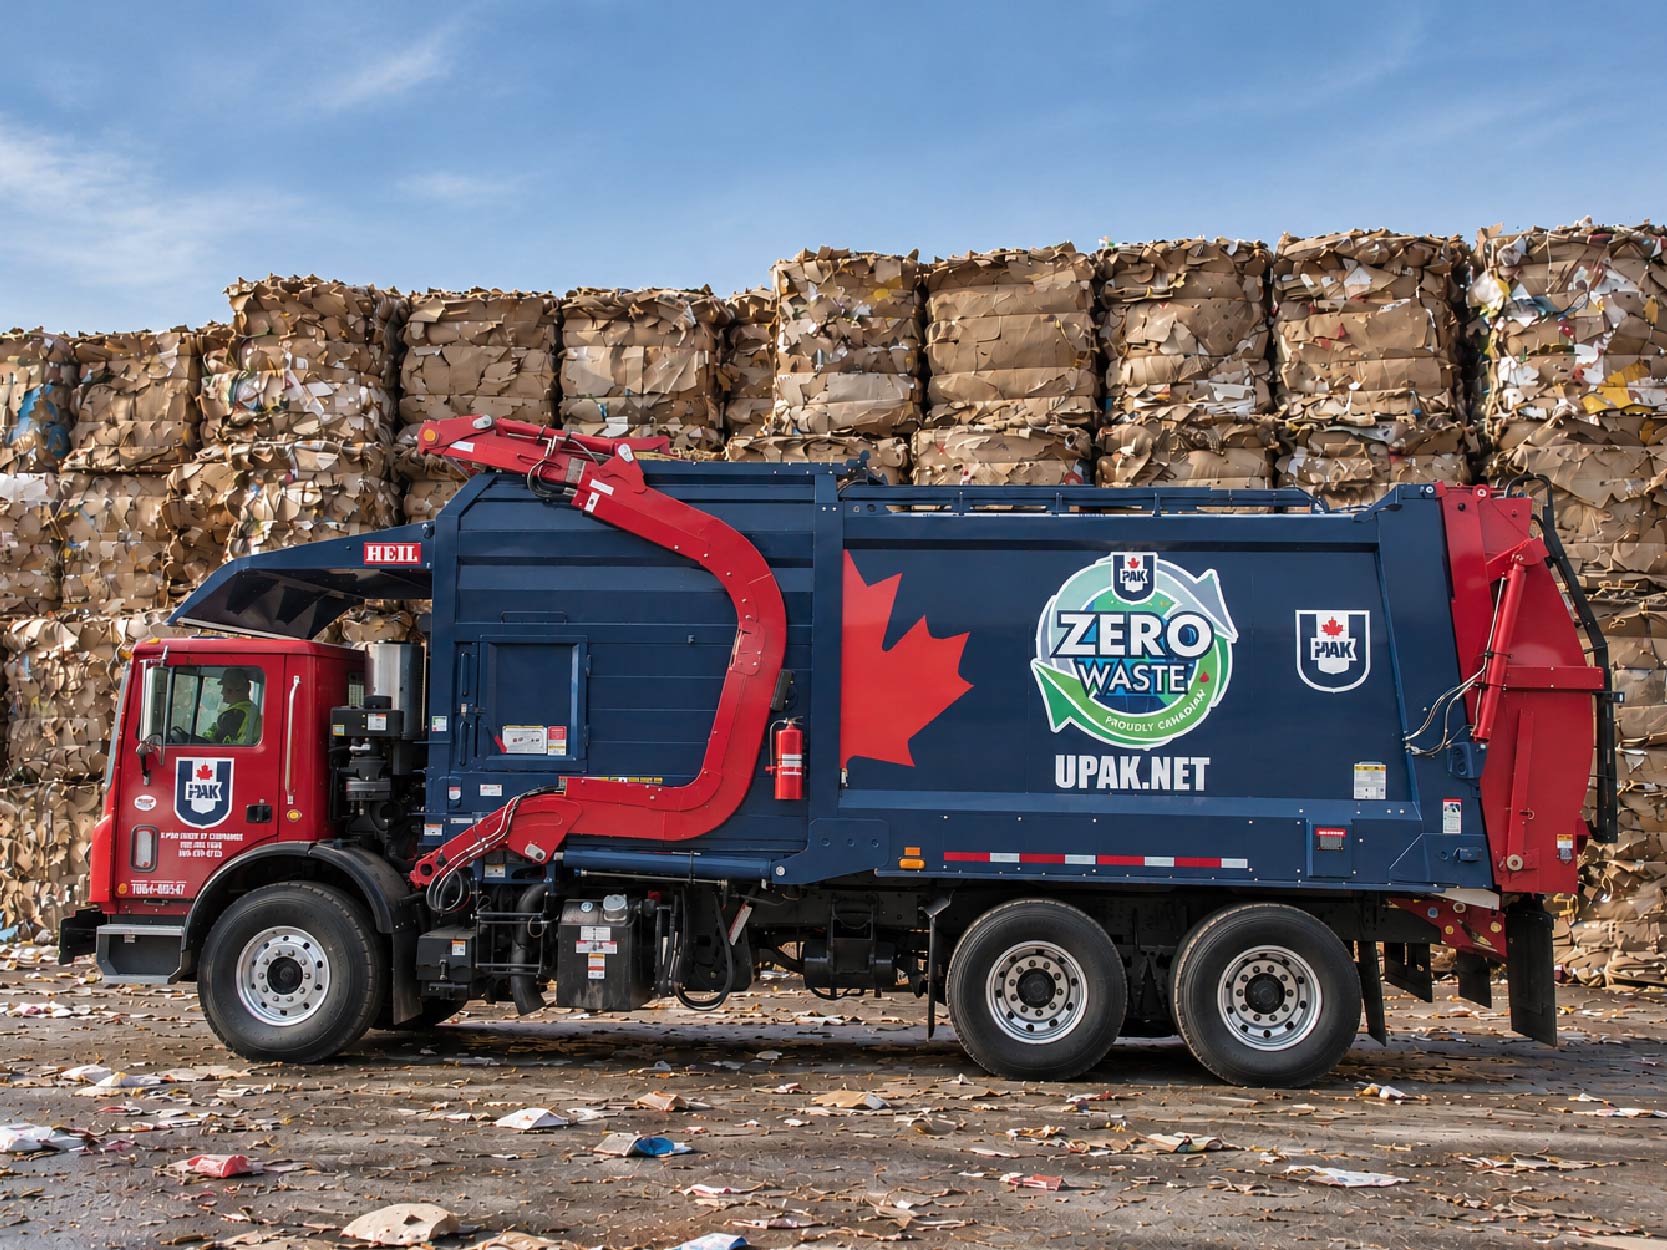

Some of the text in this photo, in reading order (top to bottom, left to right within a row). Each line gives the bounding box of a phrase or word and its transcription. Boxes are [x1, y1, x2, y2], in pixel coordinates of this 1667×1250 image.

[365, 545, 418, 562] HEIL
[1054, 612, 1213, 658] ZERO
[1078, 664, 1185, 692] WASTE
[1105, 715, 1154, 732] PROUDLY
[1054, 754, 1211, 792] UPAK.NET
